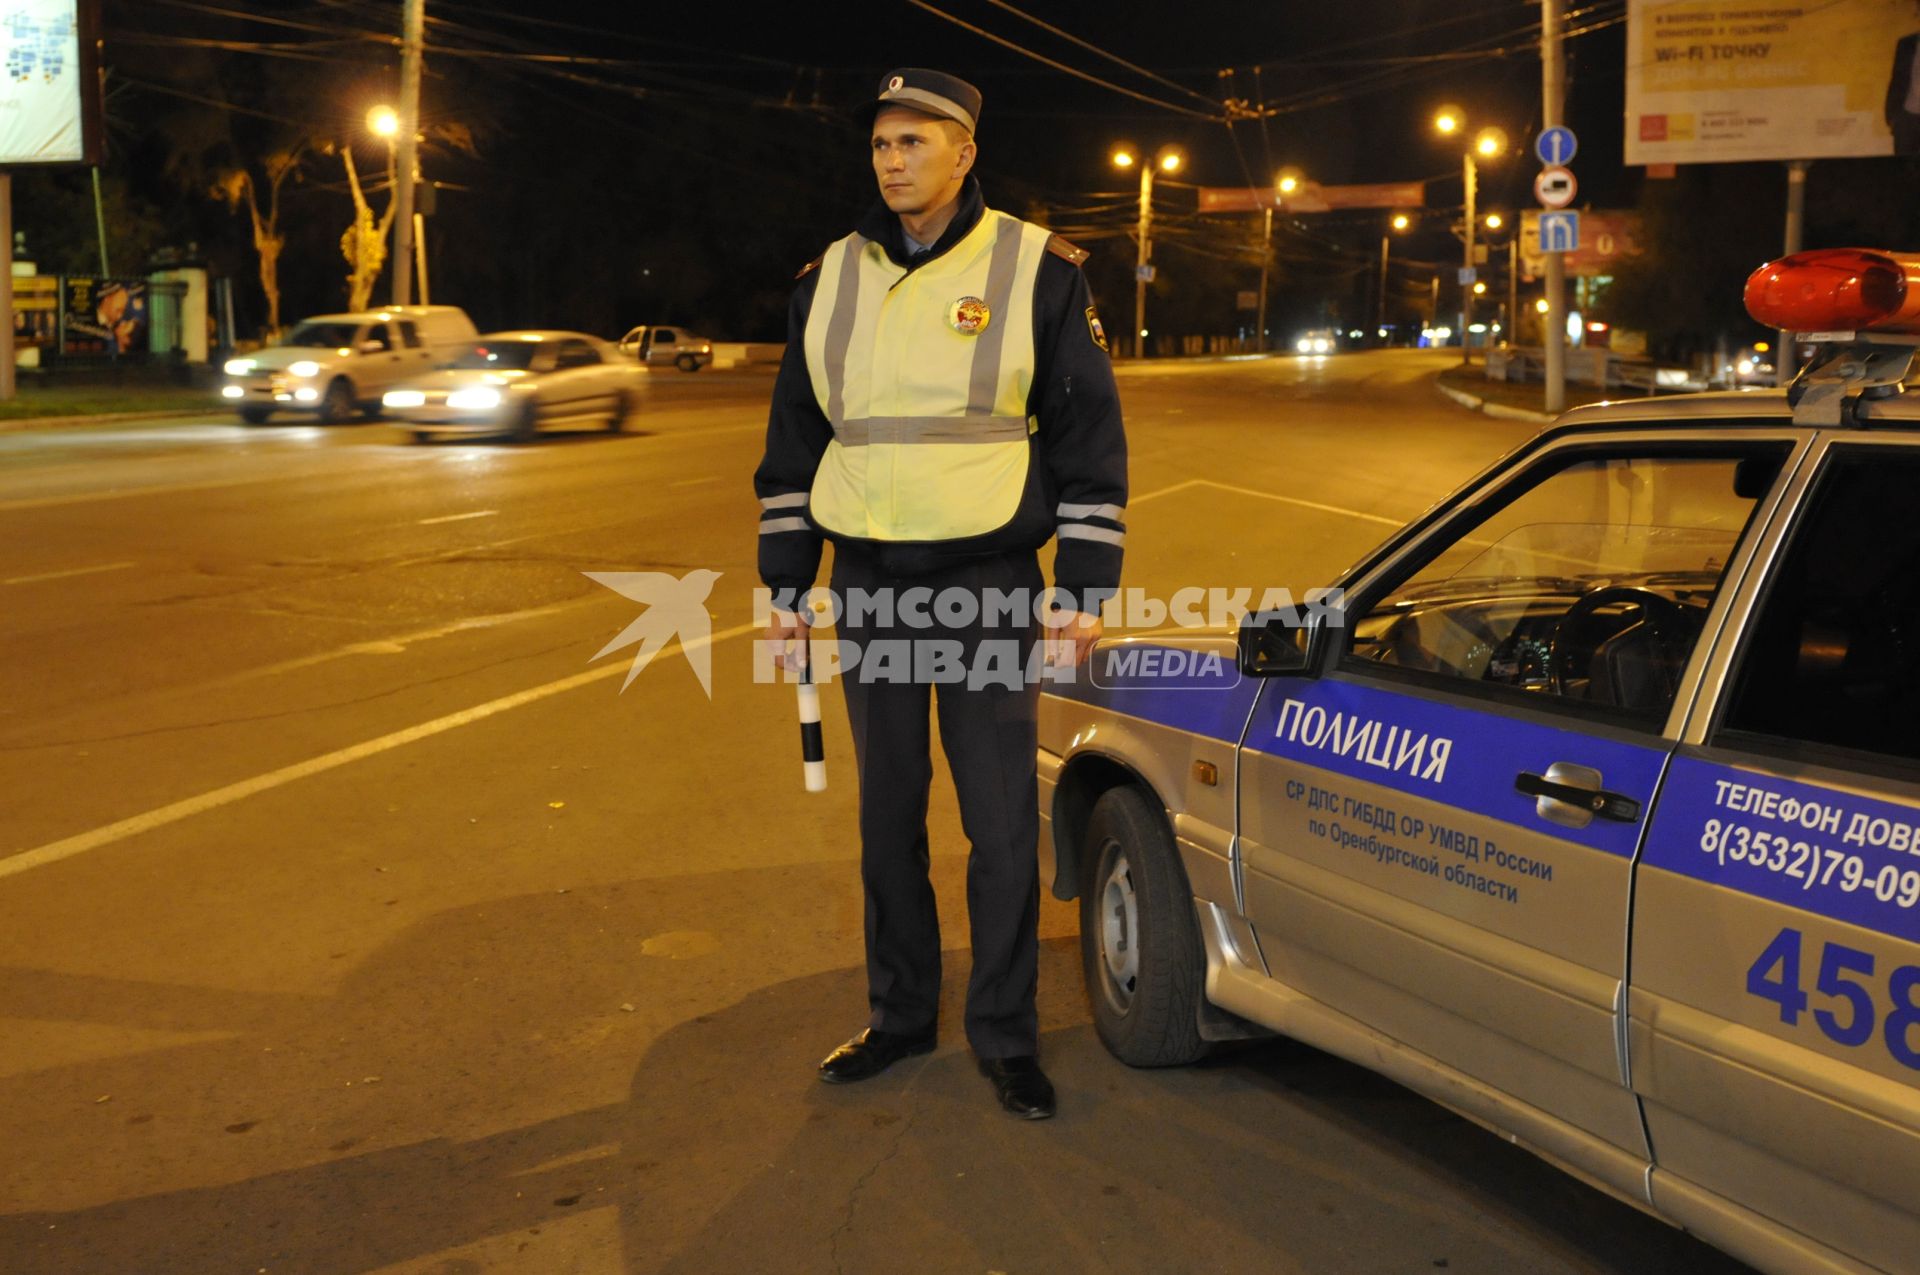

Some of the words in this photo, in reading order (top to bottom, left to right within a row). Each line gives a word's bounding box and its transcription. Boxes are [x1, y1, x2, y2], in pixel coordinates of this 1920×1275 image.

[1275, 698, 1453, 784] ПОЛИЦИЯ
[1286, 780, 1305, 800] СР
[1308, 786, 1339, 813] ДПС
[1343, 796, 1396, 836] ГИБДД
[1400, 815, 1424, 838] ОР
[1429, 823, 1479, 864] УМВД
[1484, 840, 1552, 881] России
[1715, 780, 1843, 835] ТЕЛЕФОН
[1309, 819, 1326, 837] по
[1330, 822, 1439, 877] Оренбургской
[1444, 863, 1517, 904] области
